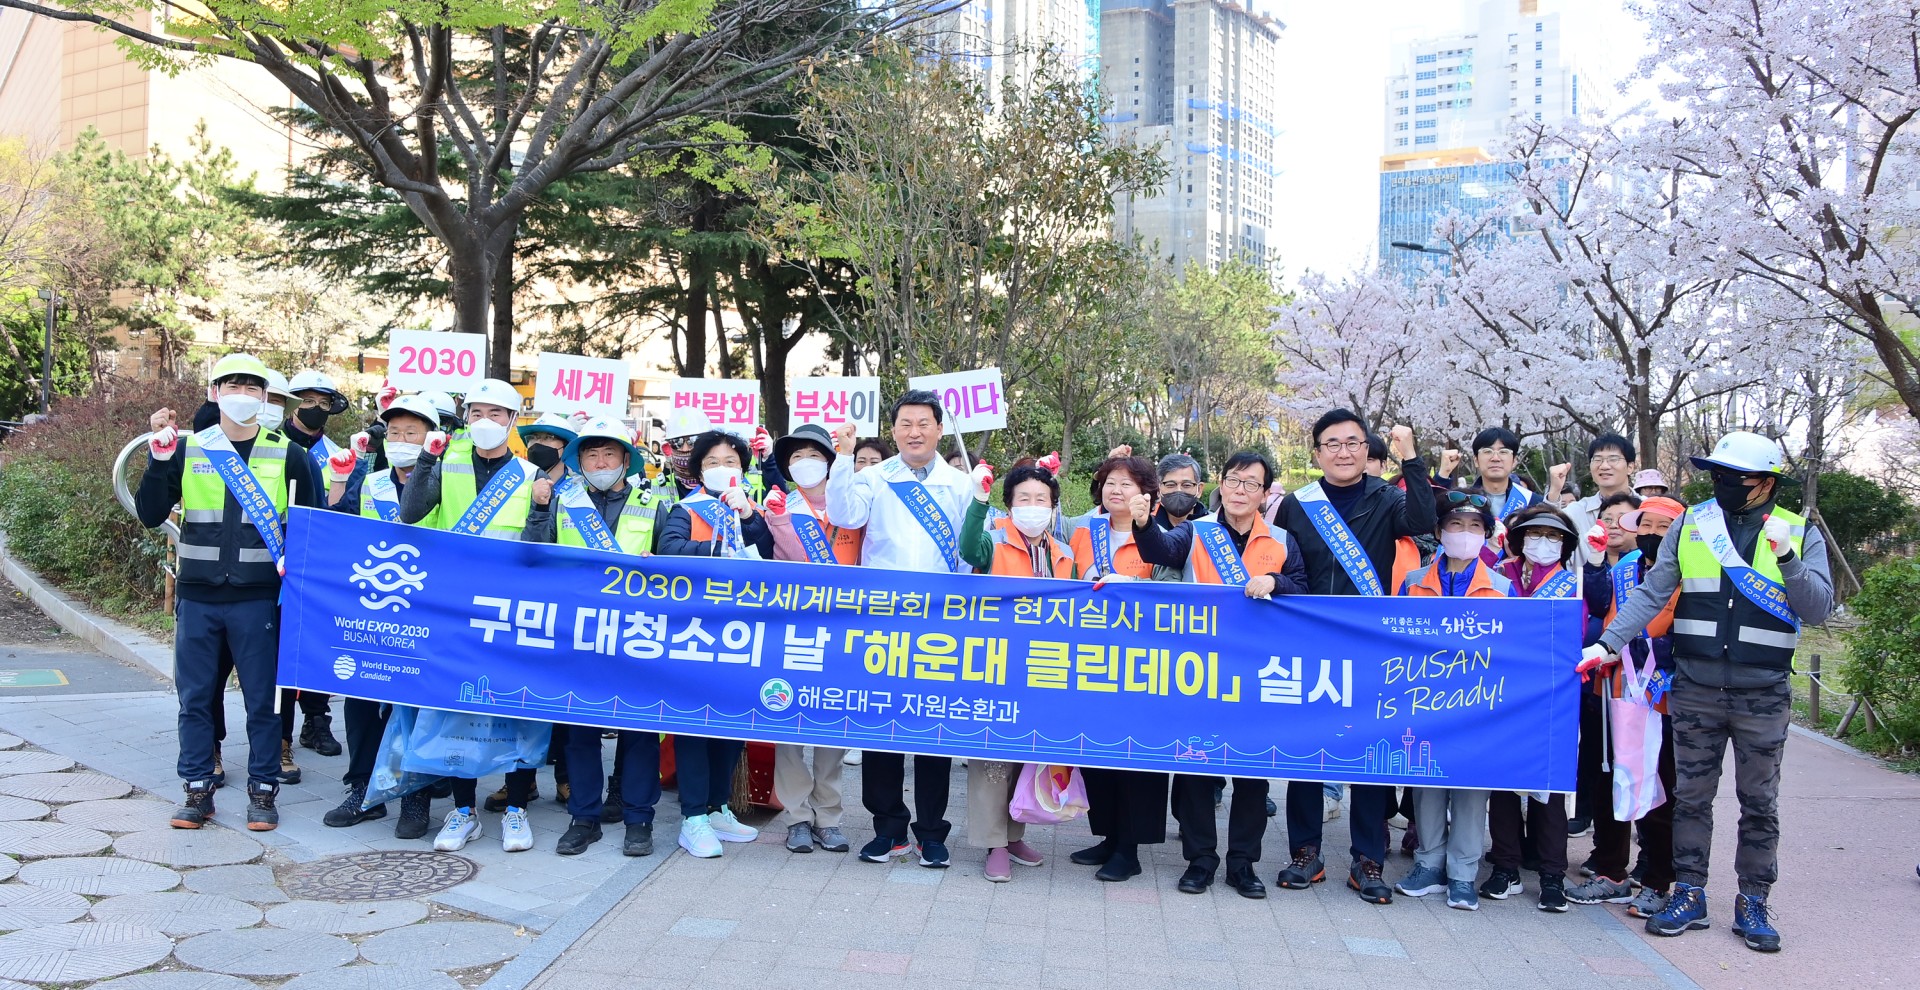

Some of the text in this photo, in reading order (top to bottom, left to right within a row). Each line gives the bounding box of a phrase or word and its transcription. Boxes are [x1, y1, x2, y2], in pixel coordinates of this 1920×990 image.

[399, 345, 477, 377] 2030
[552, 368, 615, 405] 세계
[932, 382, 1000, 419] 이다
[794, 390, 875, 424] 부산이
[601, 566, 1217, 637] 2030 부산세계박람회 BIE 현지실사 대비
[334, 616, 430, 639] World EXPO 2030
[1381, 617, 1431, 626] 살기 좋은 도시
[1391, 626, 1406, 634] 오고
[1423, 628, 1439, 636] 도시
[1440, 616, 1503, 640] 해운대
[343, 630, 416, 650] BUSAN, KOREA
[469, 596, 558, 650] 구민
[573, 606, 766, 668] 대청소의
[782, 625, 832, 672] 날
[1258, 655, 1353, 708] 실시
[359, 670, 392, 682] Candidate
[361, 660, 421, 675] World Expo 2030
[1380, 646, 1492, 685] BUSAN
[798, 685, 1020, 724] 해운대구 자원순환과
[1376, 675, 1505, 719] is Ready!
